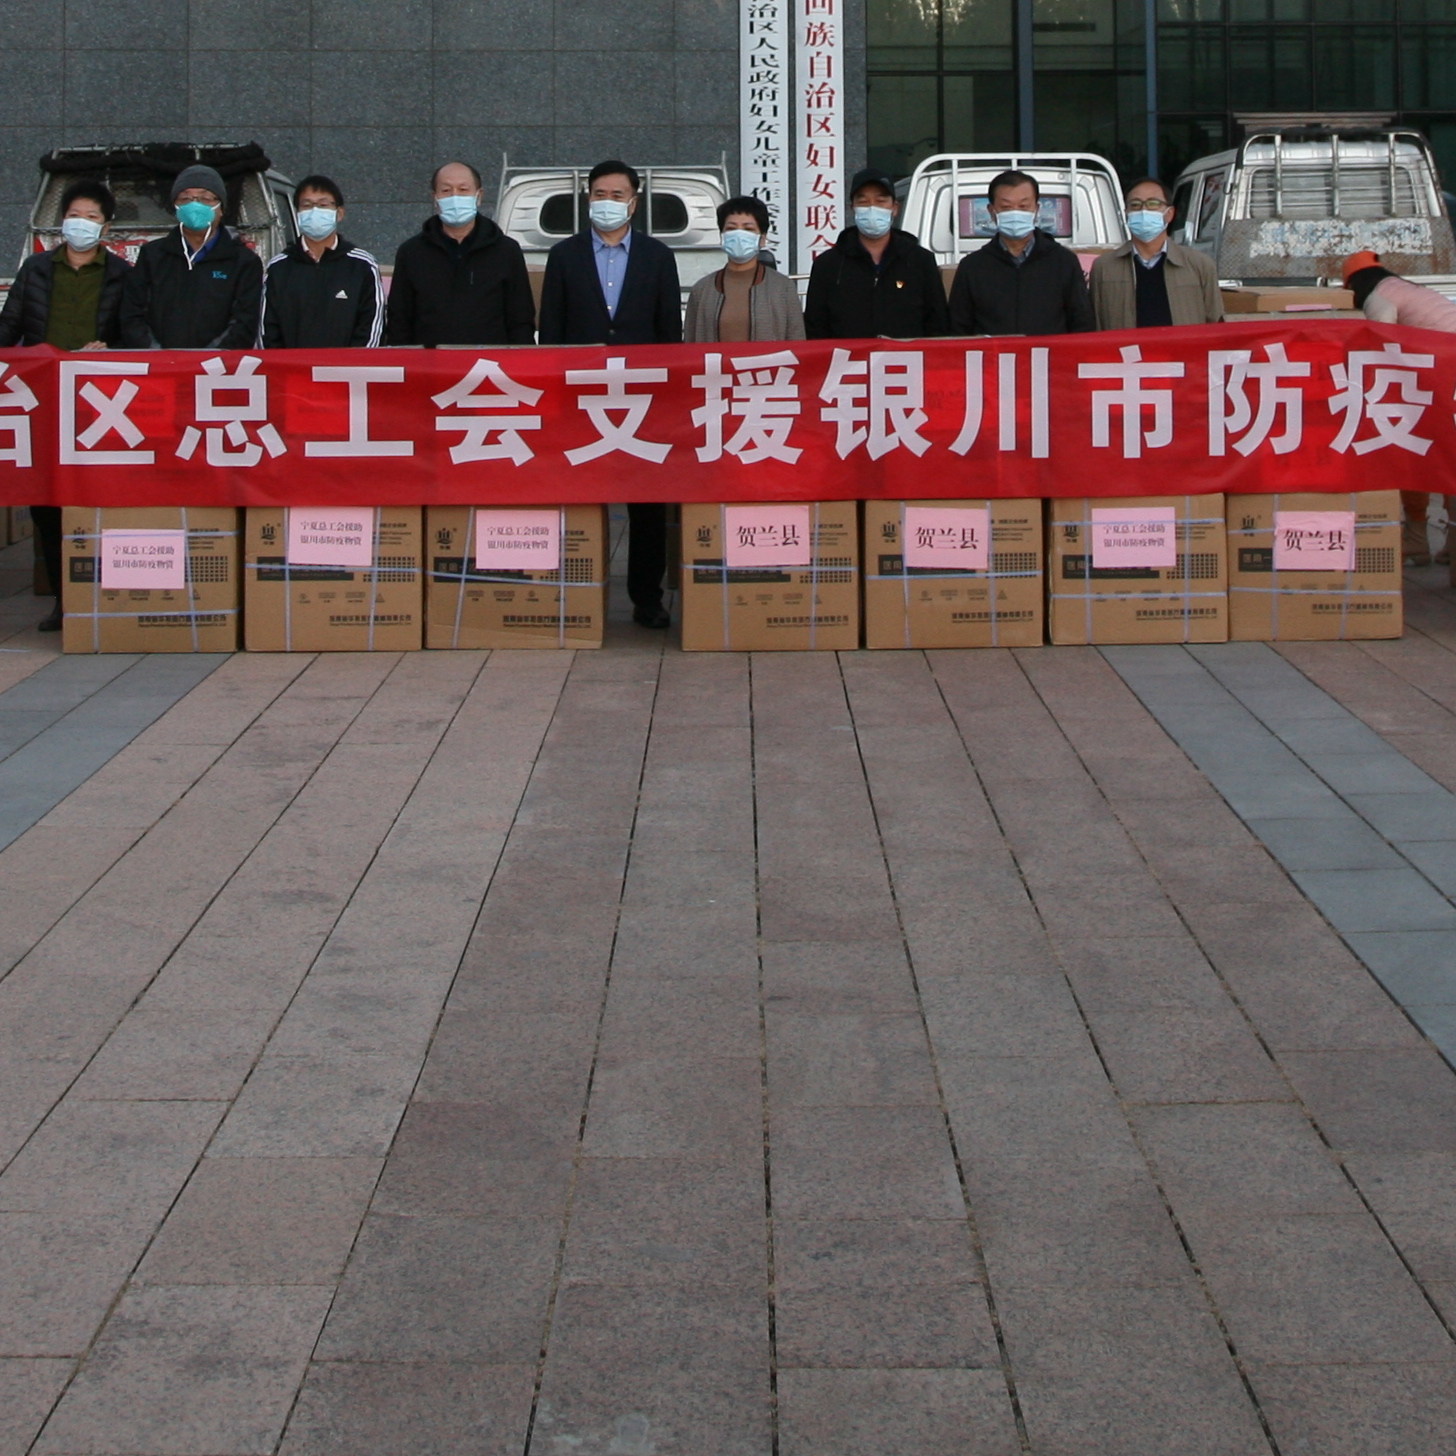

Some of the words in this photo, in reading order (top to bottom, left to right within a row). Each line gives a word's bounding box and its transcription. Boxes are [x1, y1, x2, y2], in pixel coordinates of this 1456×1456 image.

[300, 521, 363, 532] 宁夏总工会援助
[487, 525, 550, 537] 宁夏总工会援助
[1102, 523, 1166, 535] 宁夏总工会援助
[300, 534, 362, 546] 银川市防疫物资
[735, 525, 800, 548] 贺兰县
[915, 526, 979, 551] 贺兰县
[1283, 529, 1347, 552] 贺兰县
[112, 545, 175, 556] 宁夏总工会援助
[487, 539, 549, 551] 银川市防疫物资
[112, 558, 174, 570] 银川市防疫物资
